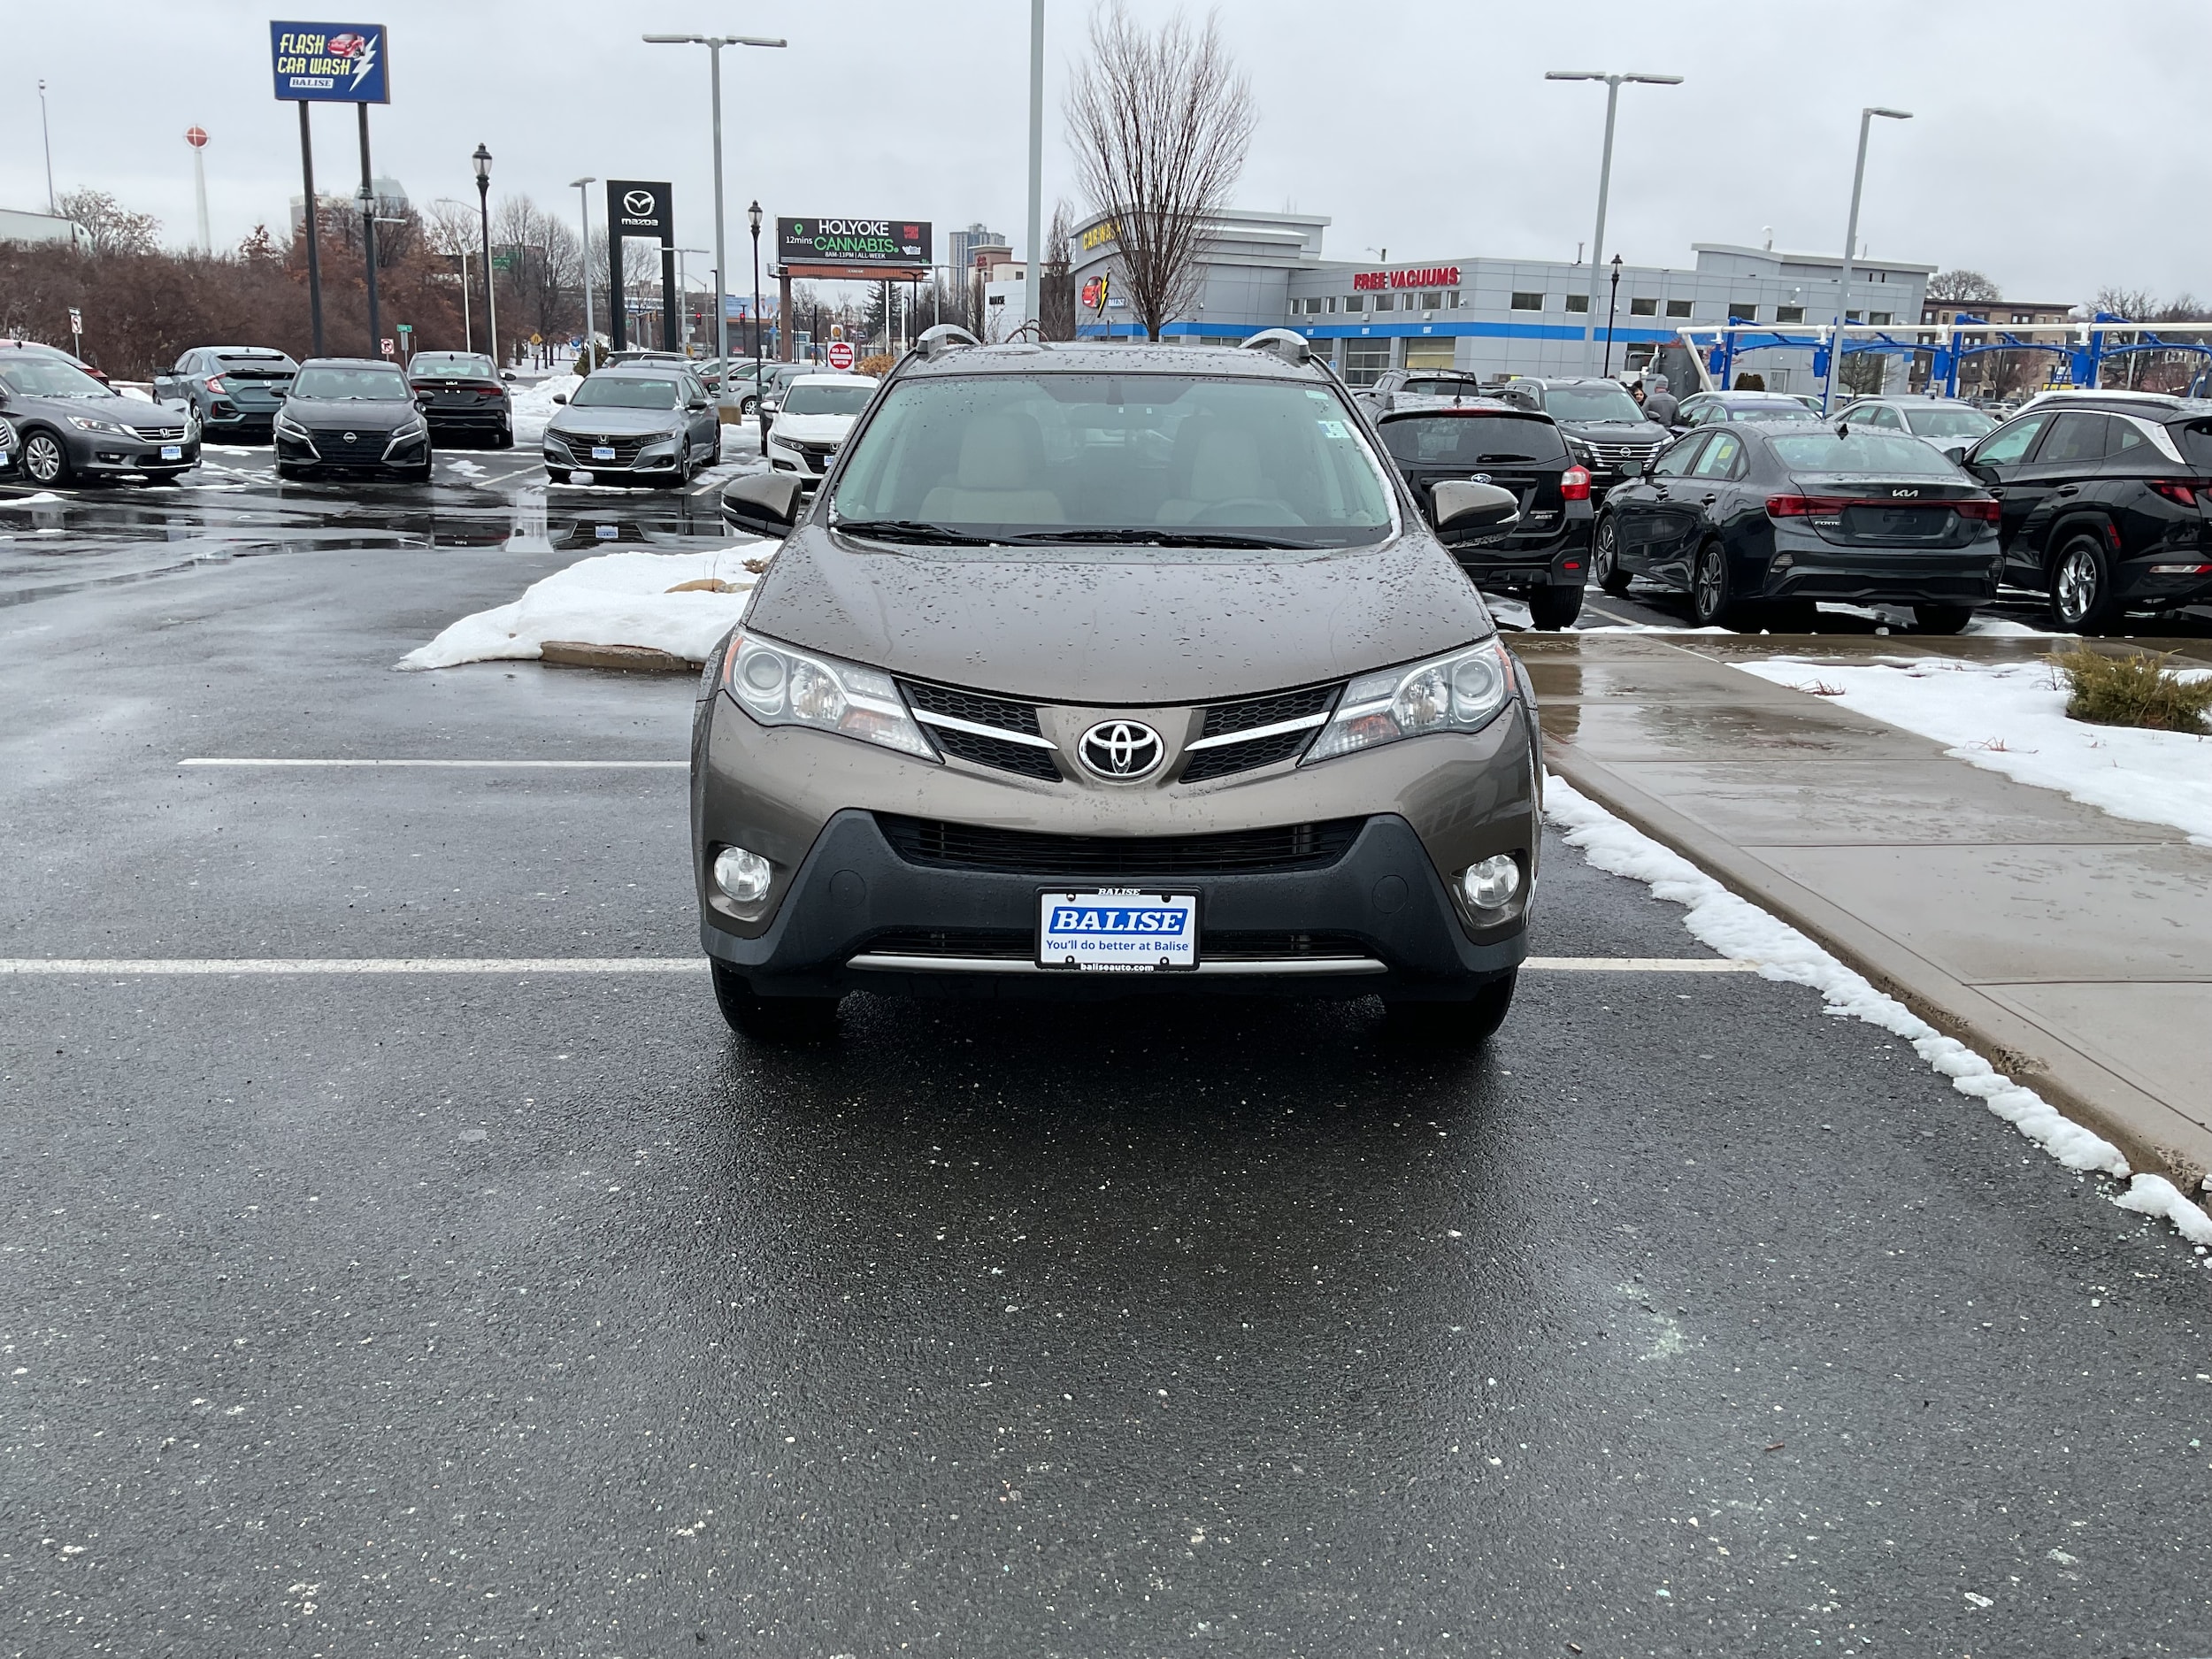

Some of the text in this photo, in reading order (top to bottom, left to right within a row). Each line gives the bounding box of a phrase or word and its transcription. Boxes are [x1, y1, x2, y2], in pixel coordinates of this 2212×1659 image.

[279, 34, 326, 55] FLASH
[277, 57, 351, 75] CAR WASH
[292, 78, 332, 87] BALISE
[818, 219, 889, 236] HOLYOKE
[786, 235, 813, 245] 12mins
[1082, 228, 1098, 251] CAR
[1354, 266, 1461, 290] FREE VACUUMS
[1098, 887, 1141, 896] BALISE
[1054, 910, 1183, 932] BALISE
[1046, 940, 1188, 951] You'll do better at Balise
[1080, 963, 1154, 972] baliseauto.com
